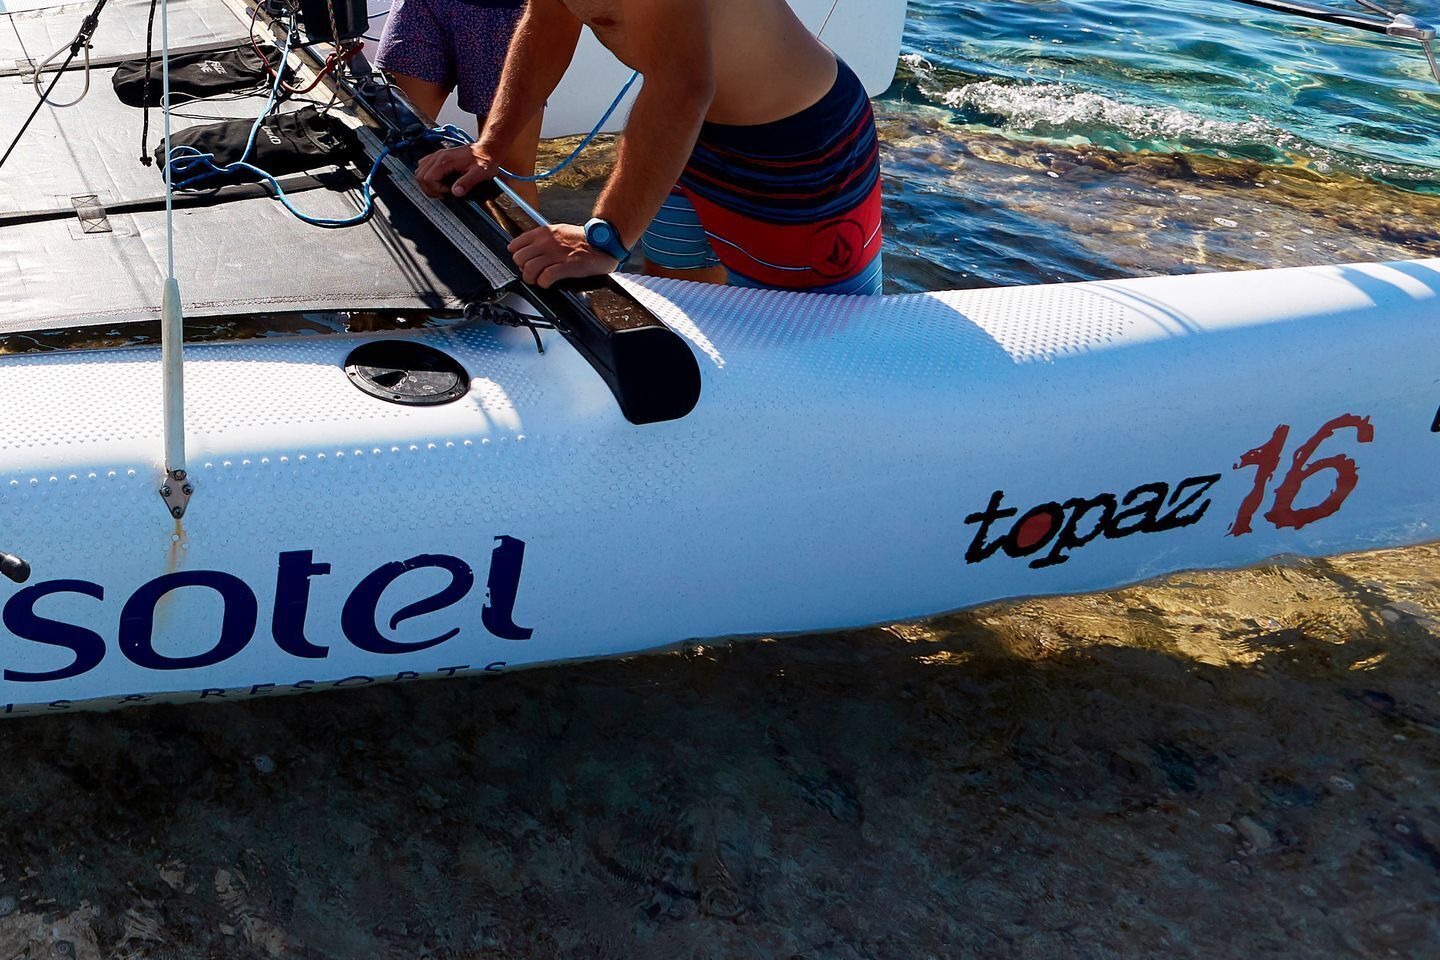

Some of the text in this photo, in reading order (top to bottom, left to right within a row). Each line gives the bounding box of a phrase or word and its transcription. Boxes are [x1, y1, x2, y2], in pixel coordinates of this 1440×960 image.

[964, 413, 1374, 568] topaz 16
[200, 662, 507, 700] RESORTS
